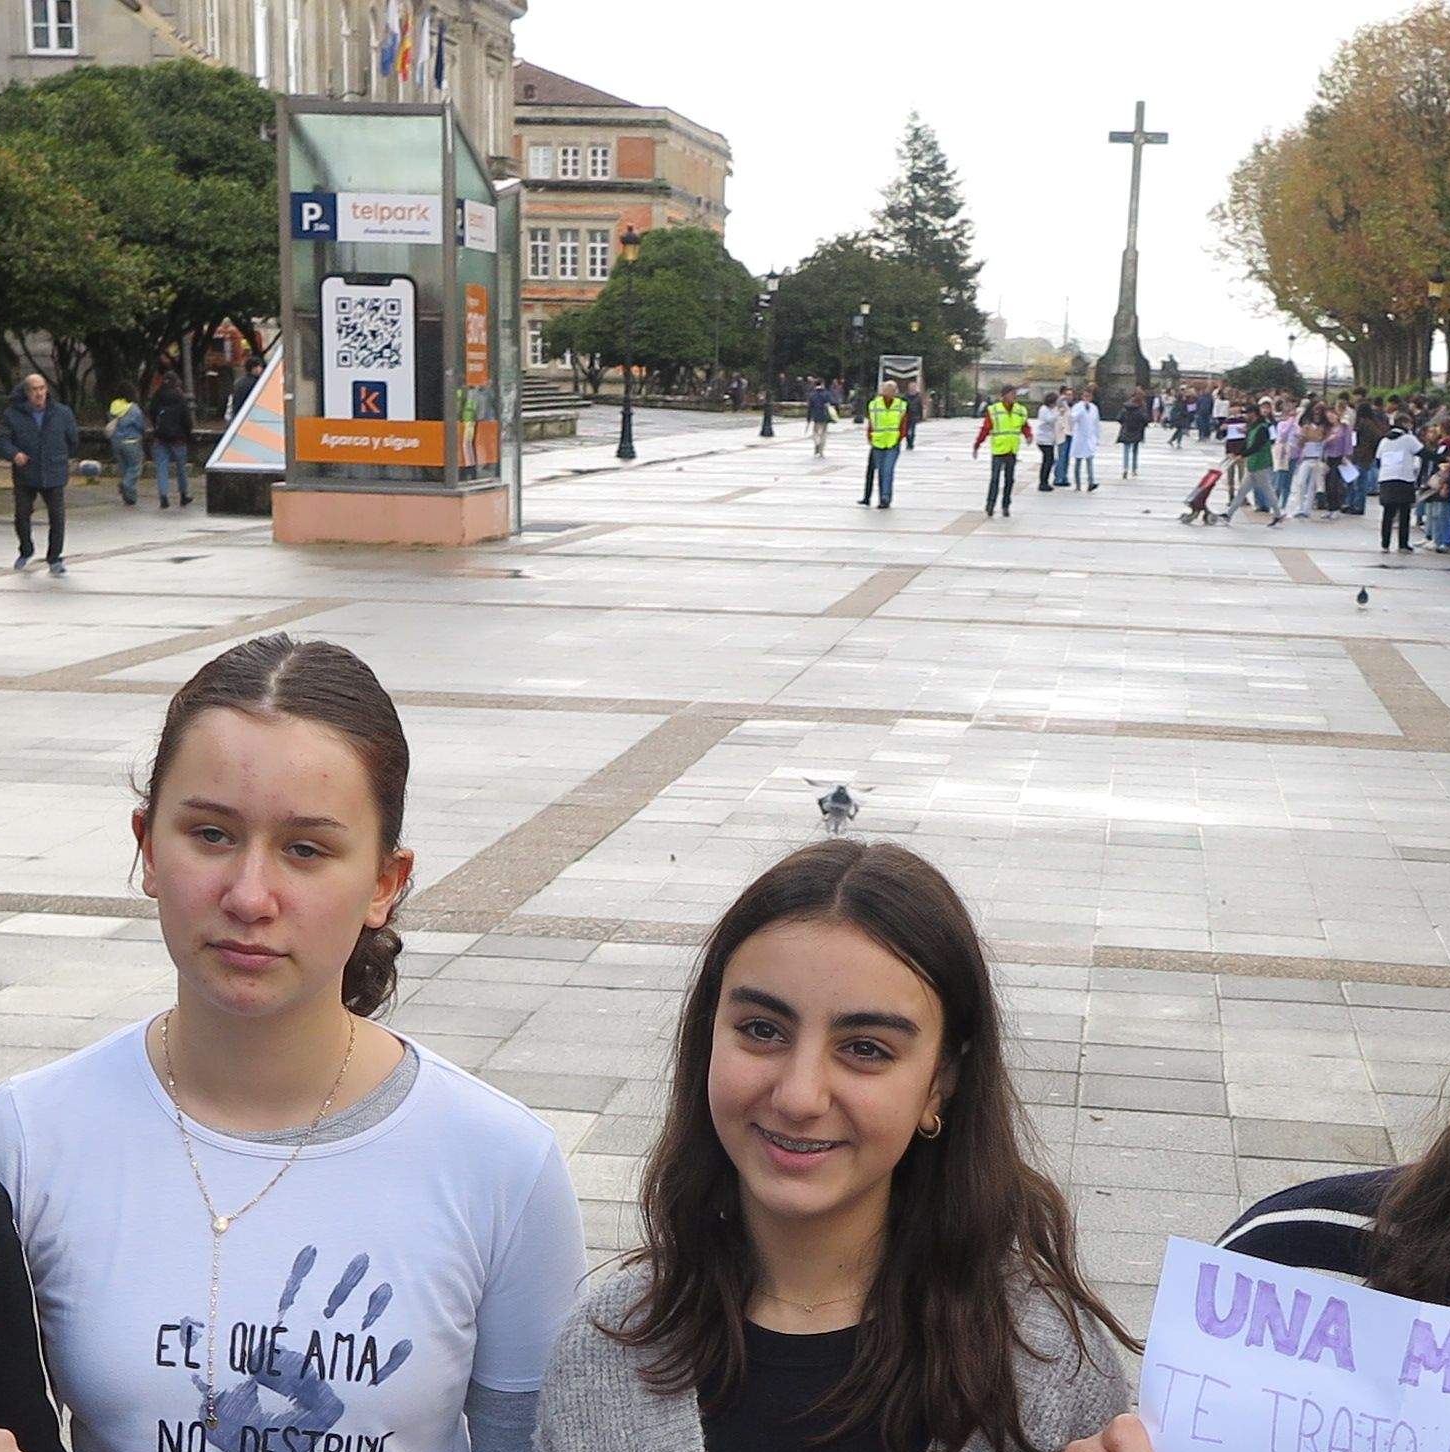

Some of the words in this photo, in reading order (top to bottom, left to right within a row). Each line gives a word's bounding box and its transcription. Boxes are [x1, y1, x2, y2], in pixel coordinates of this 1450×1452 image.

[302, 202, 323, 231] P
[352, 201, 430, 224] telpark
[383, 434, 421, 451] sigue
[1195, 1263, 1356, 1373] UNA
[156, 1323, 201, 1370] EL
[229, 1321, 288, 1377] QUE
[300, 1329, 379, 1385] AMA
[1155, 1363, 1231, 1446] TE
